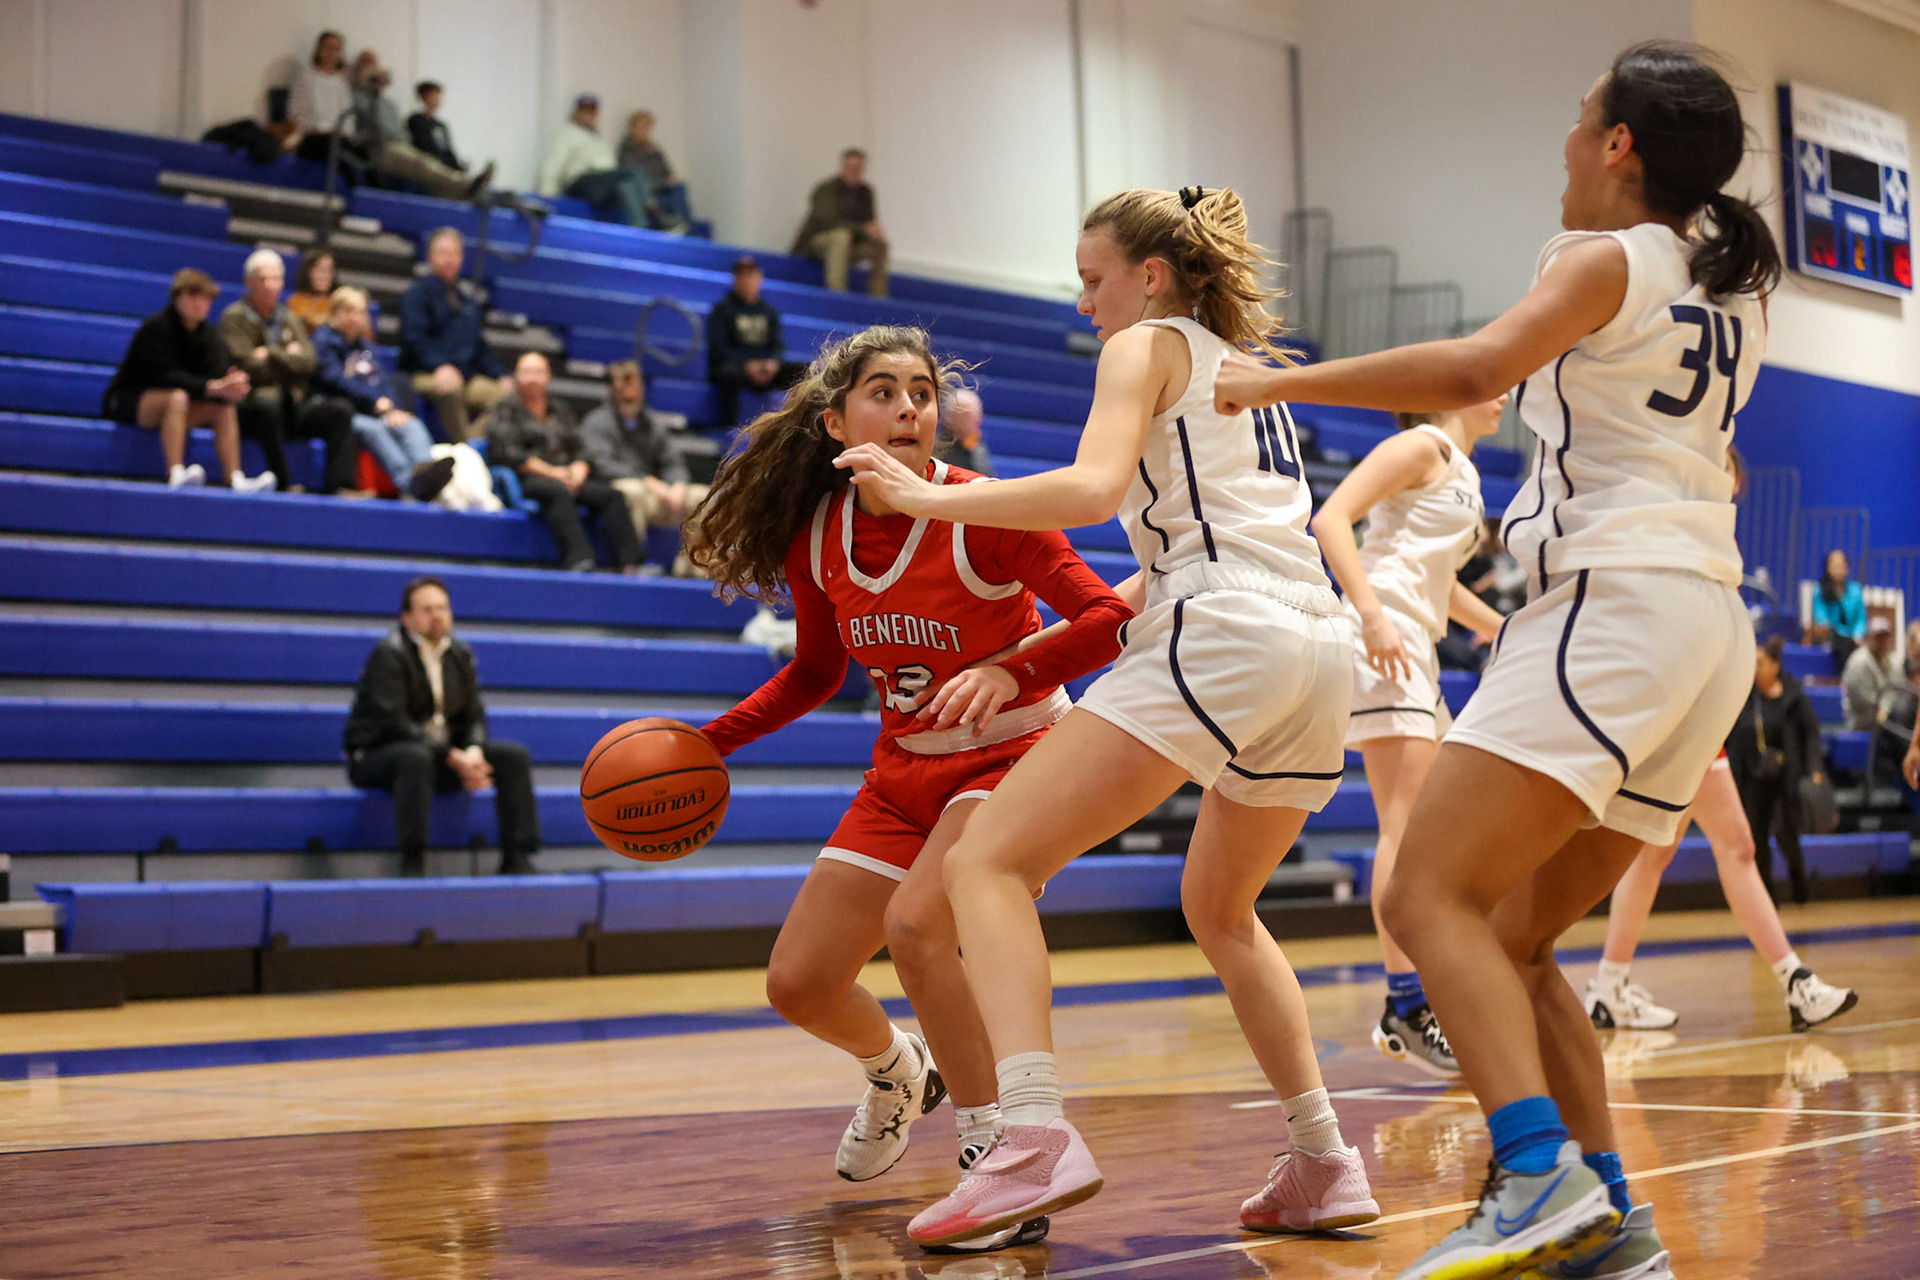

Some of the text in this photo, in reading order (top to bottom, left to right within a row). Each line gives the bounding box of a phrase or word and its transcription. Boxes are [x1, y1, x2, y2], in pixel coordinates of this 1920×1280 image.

[1646, 304, 1742, 432] 34
[1251, 402, 1300, 482] 10
[849, 613, 961, 653] BENEDICT
[616, 789, 706, 820] EVOLUTION
[622, 820, 715, 855] Wilson
